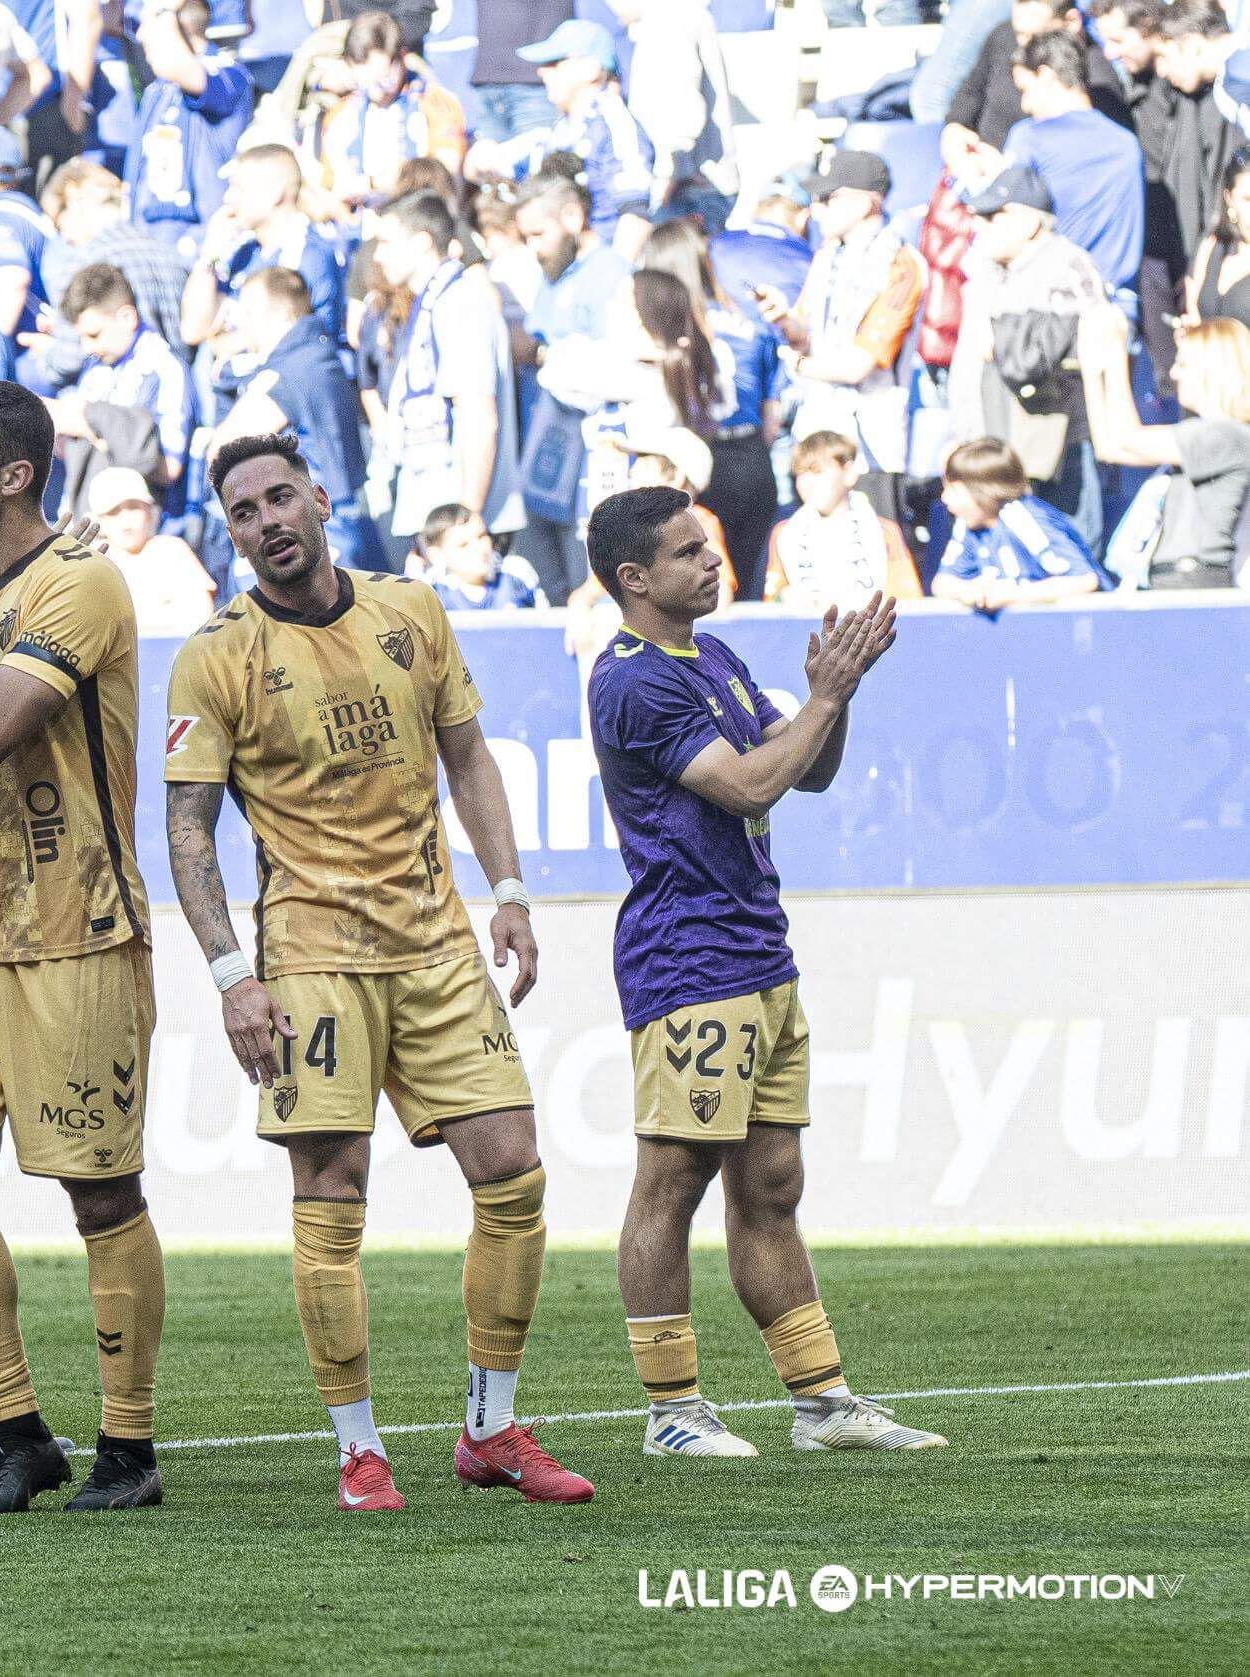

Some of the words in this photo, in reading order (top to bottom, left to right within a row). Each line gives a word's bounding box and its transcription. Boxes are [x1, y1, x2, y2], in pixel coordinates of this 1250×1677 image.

[314, 691, 350, 708] sabor
[318, 709, 329, 722] a
[330, 683, 394, 730] má
[323, 719, 400, 757] laga
[371, 756, 406, 771] Provincia
[25, 780, 66, 865] Olin
[282, 1014, 337, 1077] 14
[695, 1019, 757, 1081] 23
[39, 1102, 105, 1130] MGS
[56, 1127, 86, 1139] Seguros
